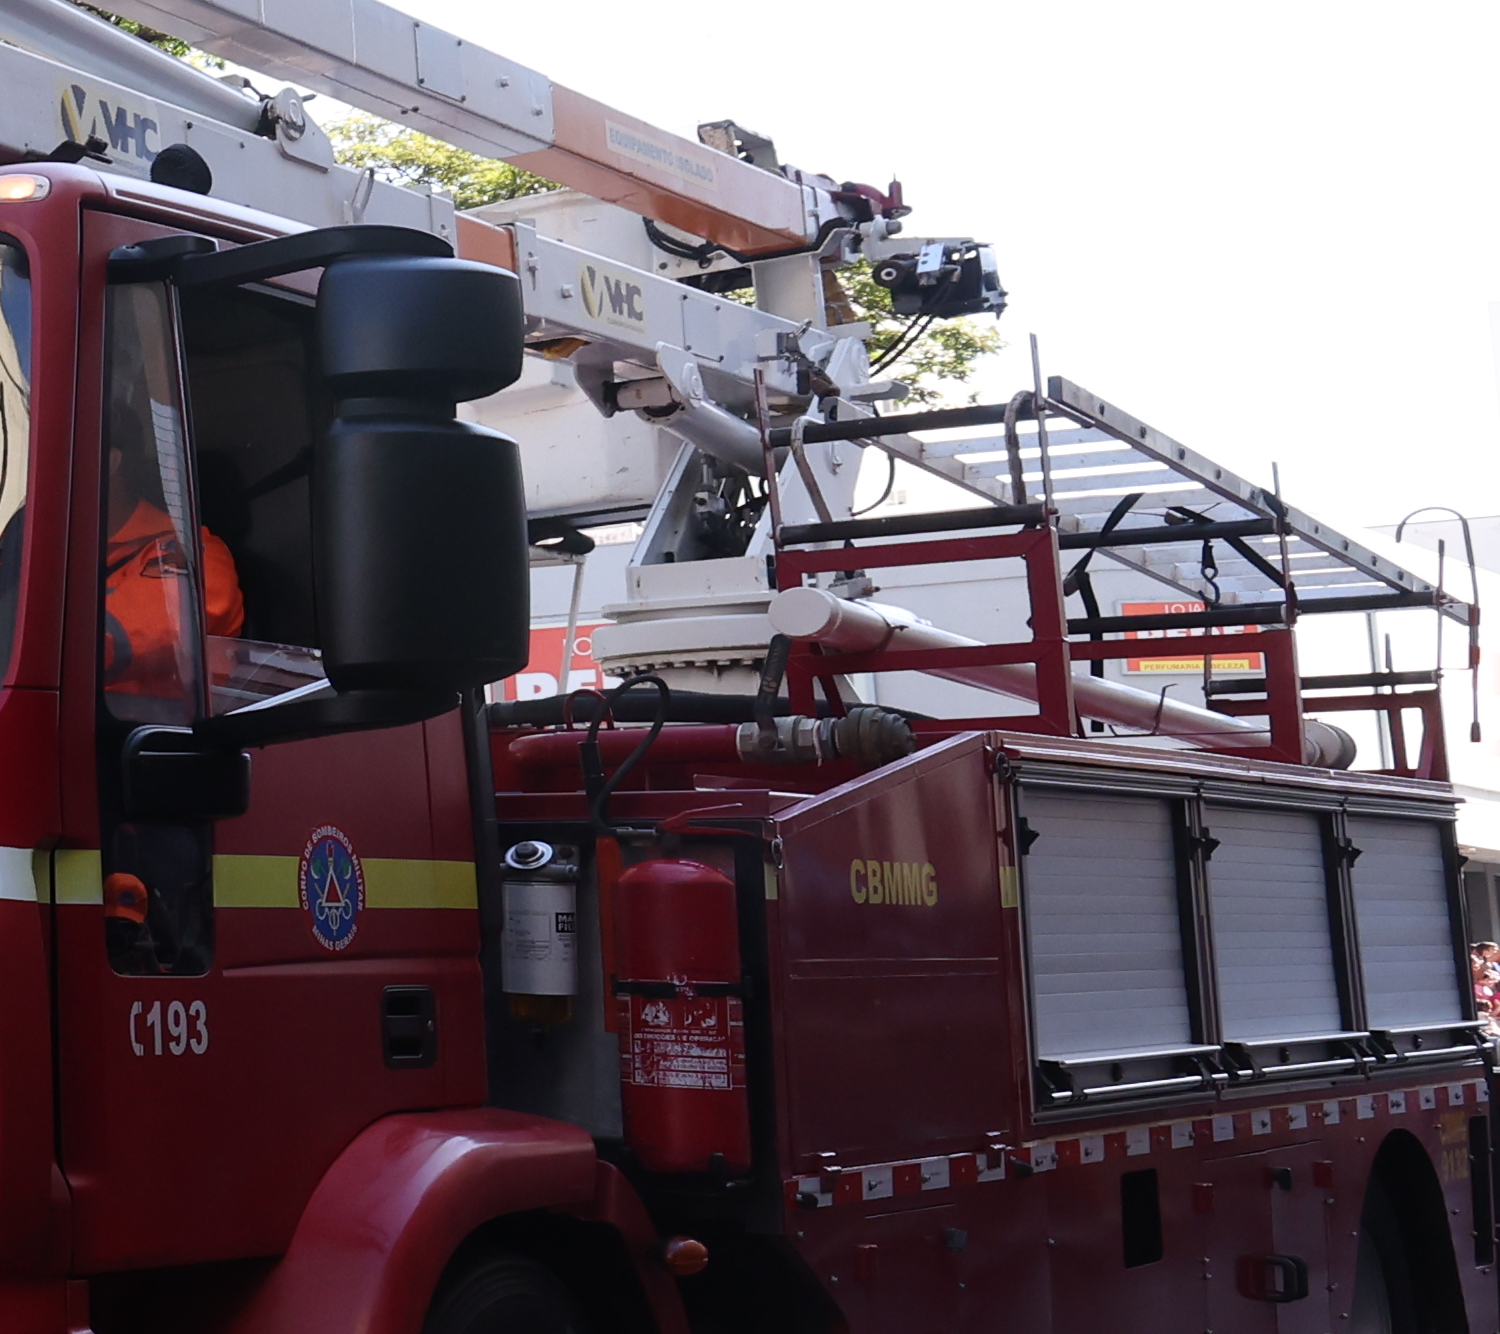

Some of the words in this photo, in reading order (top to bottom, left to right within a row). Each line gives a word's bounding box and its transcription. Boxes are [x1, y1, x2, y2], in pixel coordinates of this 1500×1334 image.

[311, 825, 353, 854] BOMBEIROS
[850, 858, 938, 906] CBMMG
[146, 999, 209, 1056] 193
